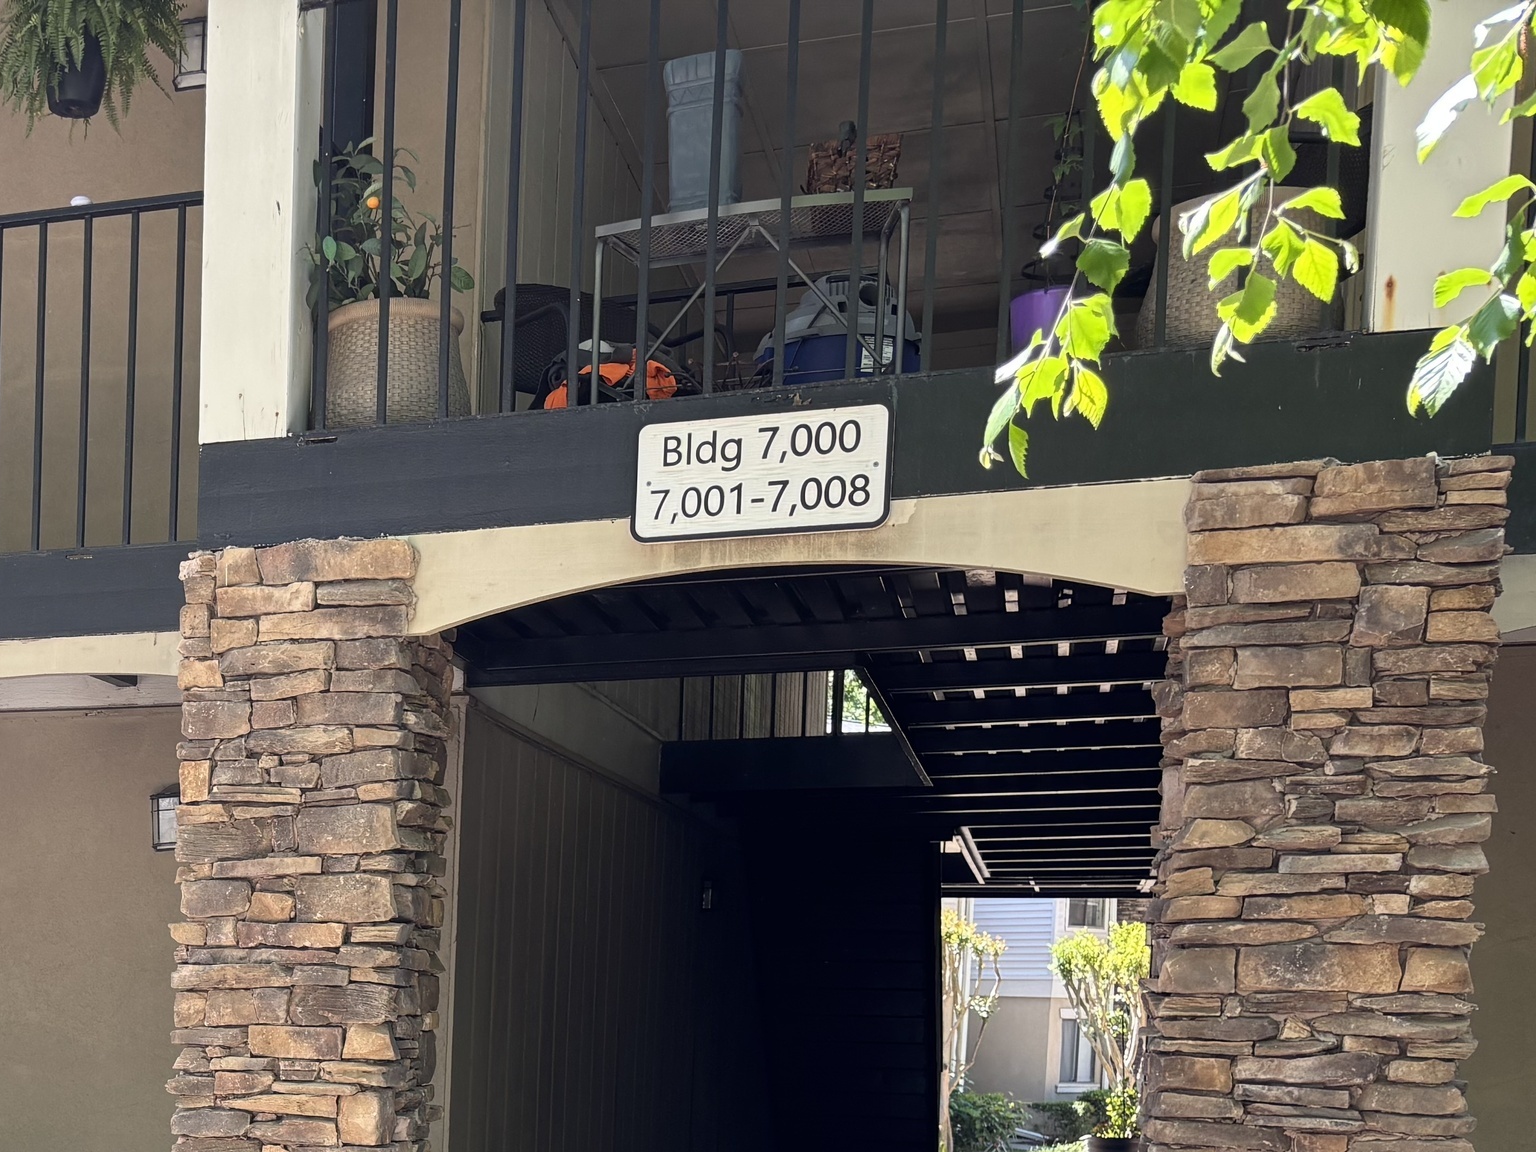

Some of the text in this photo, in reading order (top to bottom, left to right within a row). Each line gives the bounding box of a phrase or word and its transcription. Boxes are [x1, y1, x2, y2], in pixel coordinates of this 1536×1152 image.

[662, 419, 862, 472] Bldg 7,000
[650, 473, 871, 525] 7,001-7,008
